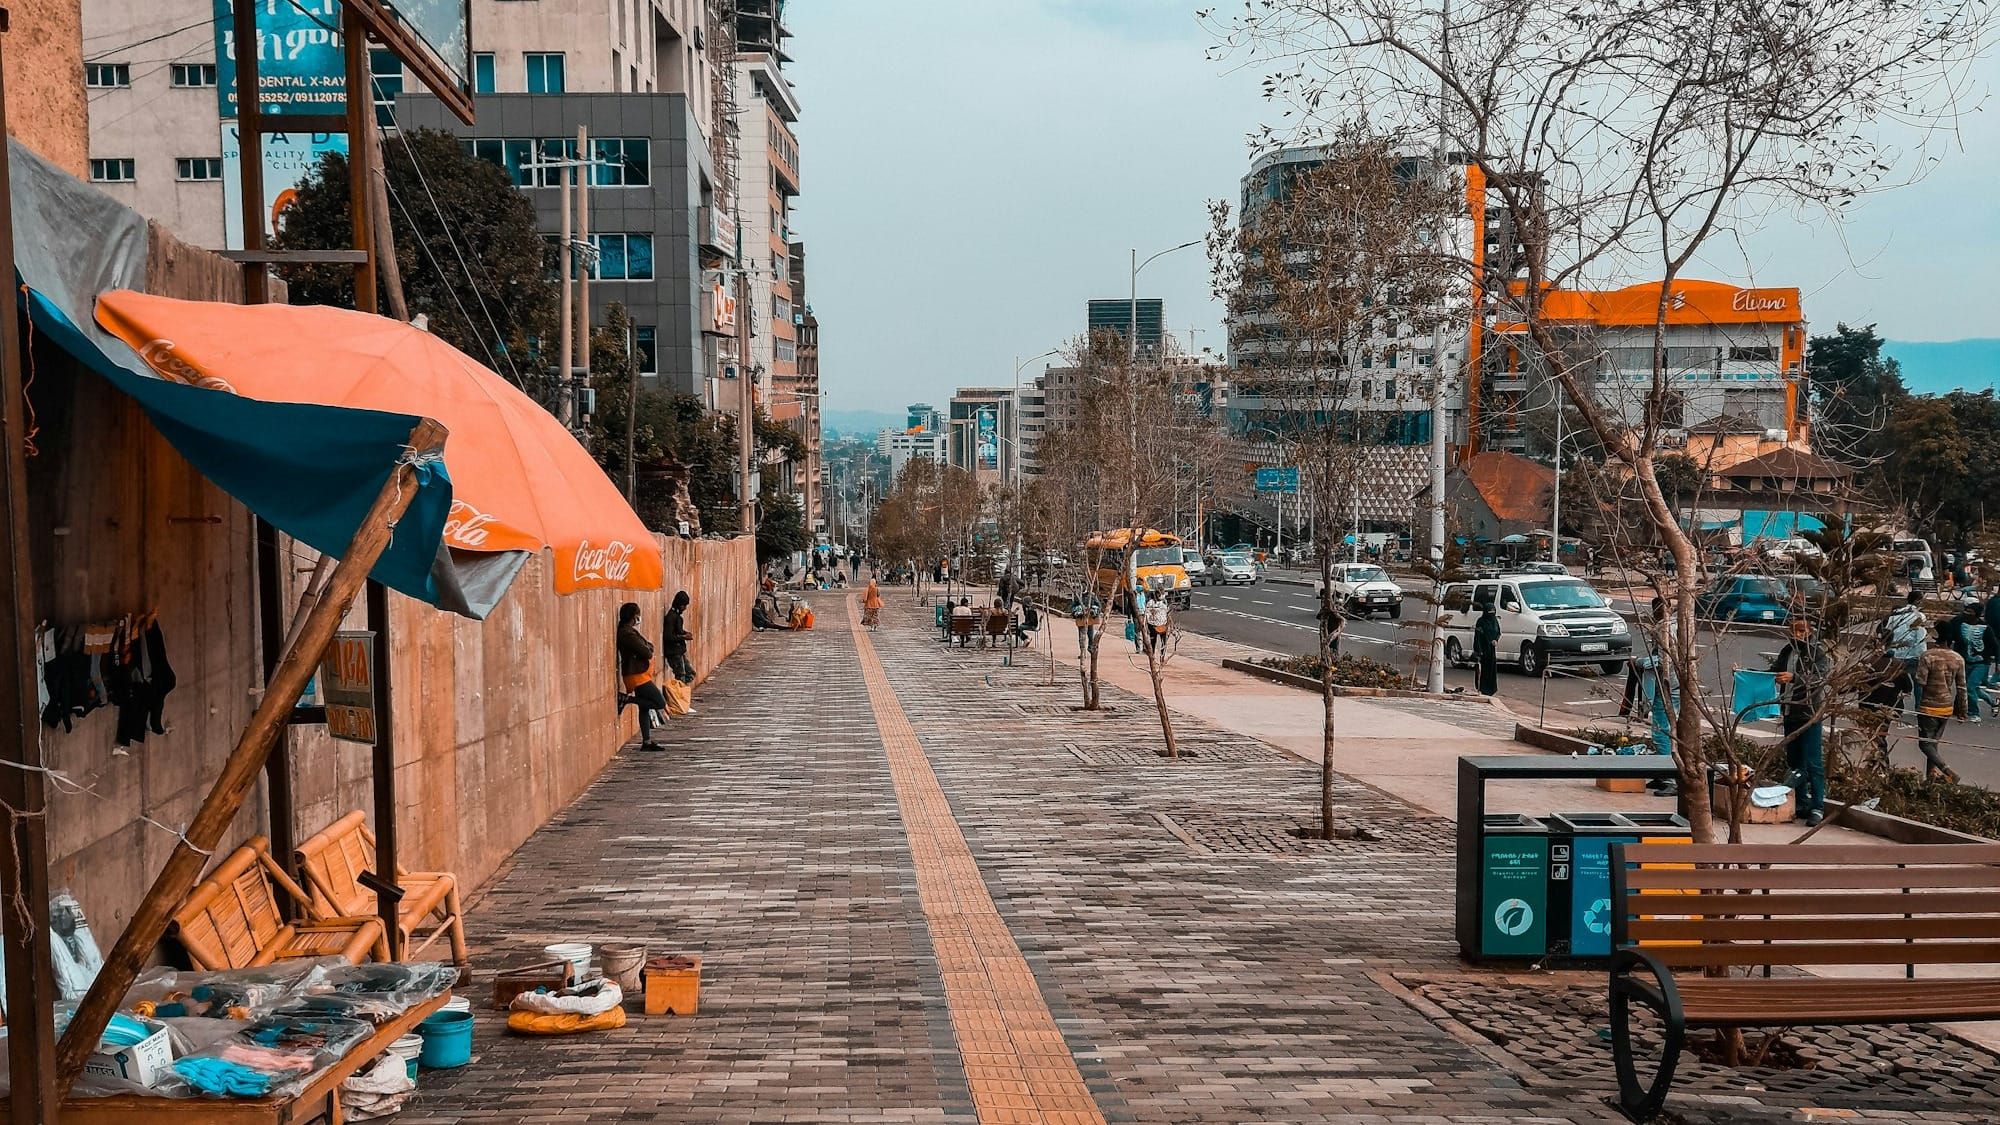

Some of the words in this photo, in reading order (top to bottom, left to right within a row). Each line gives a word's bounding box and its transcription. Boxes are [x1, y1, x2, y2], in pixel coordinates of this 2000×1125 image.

[259, 76, 306, 87] DENTAL
[310, 76, 346, 87] X-RAY
[1732, 290, 1787, 311] Eliana
